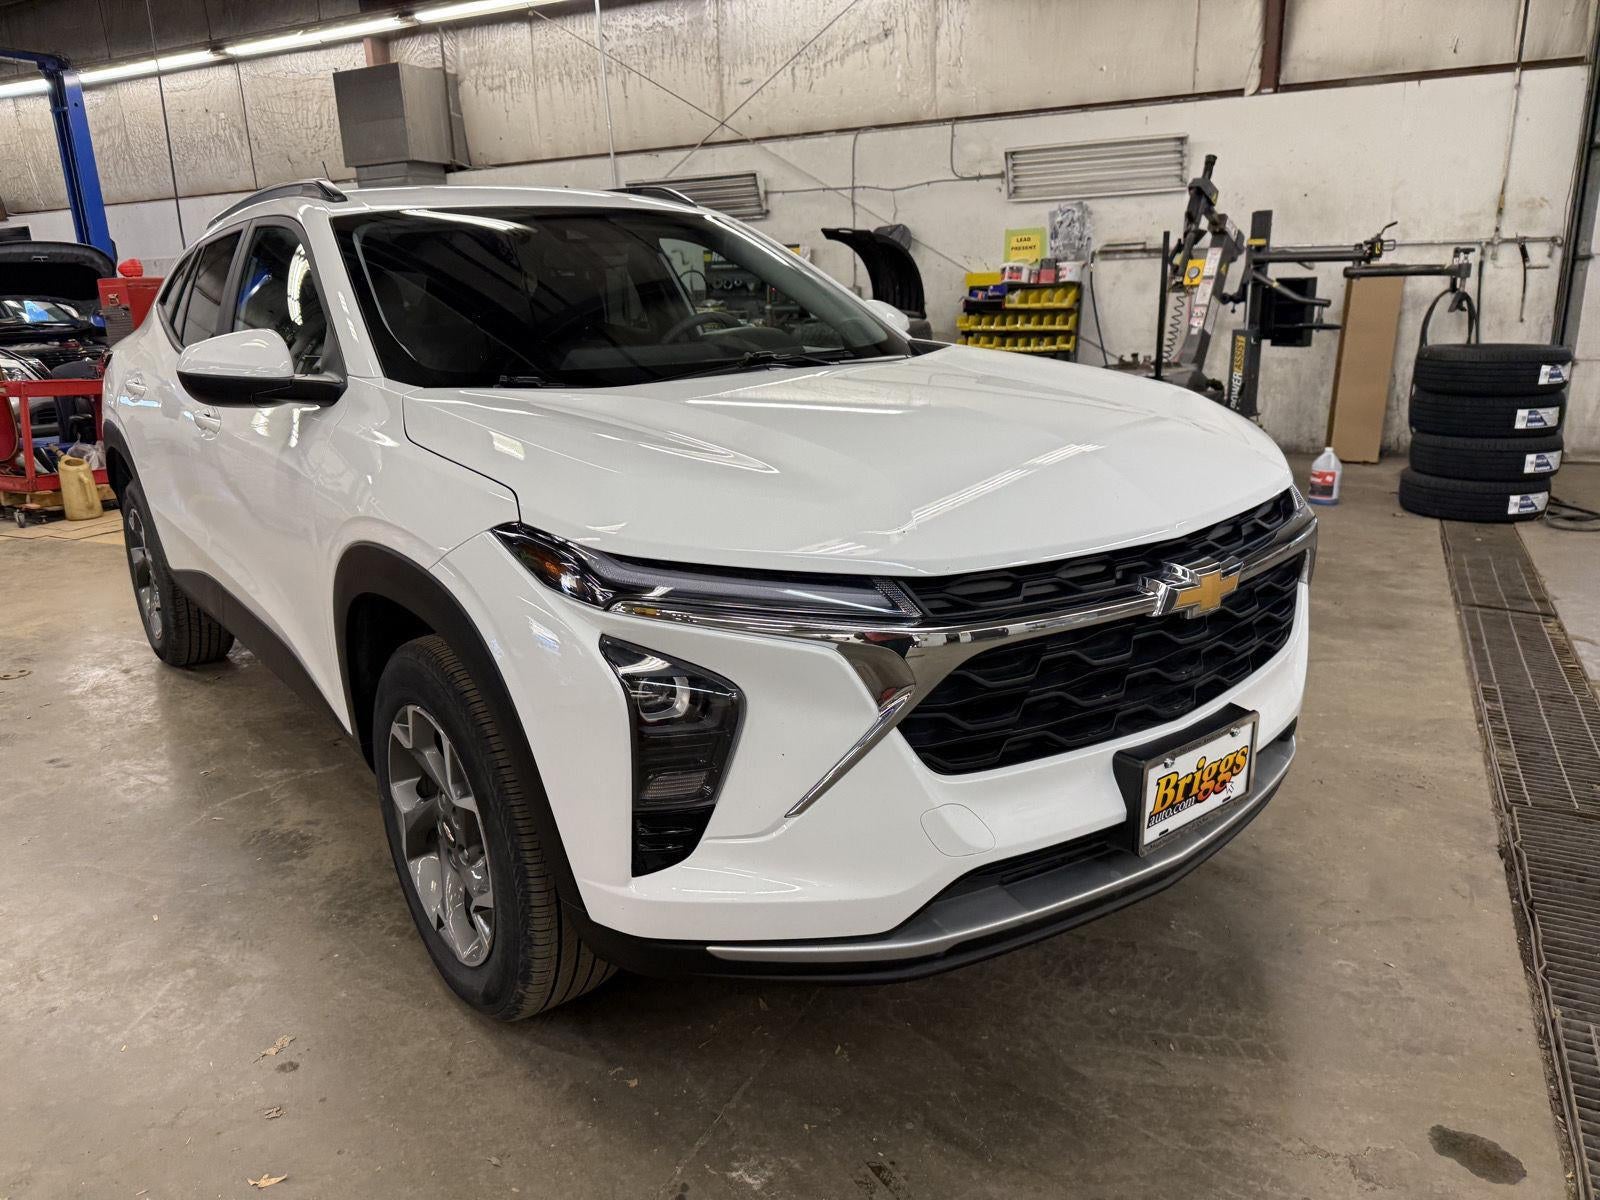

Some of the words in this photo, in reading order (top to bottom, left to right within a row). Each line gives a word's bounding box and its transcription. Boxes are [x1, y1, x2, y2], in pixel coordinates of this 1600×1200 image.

[1233, 335, 1246, 372] ASSIST
[1230, 372, 1243, 410] POWER
[1151, 745, 1249, 816] Briggs
[1148, 797, 1196, 827] auto.com
